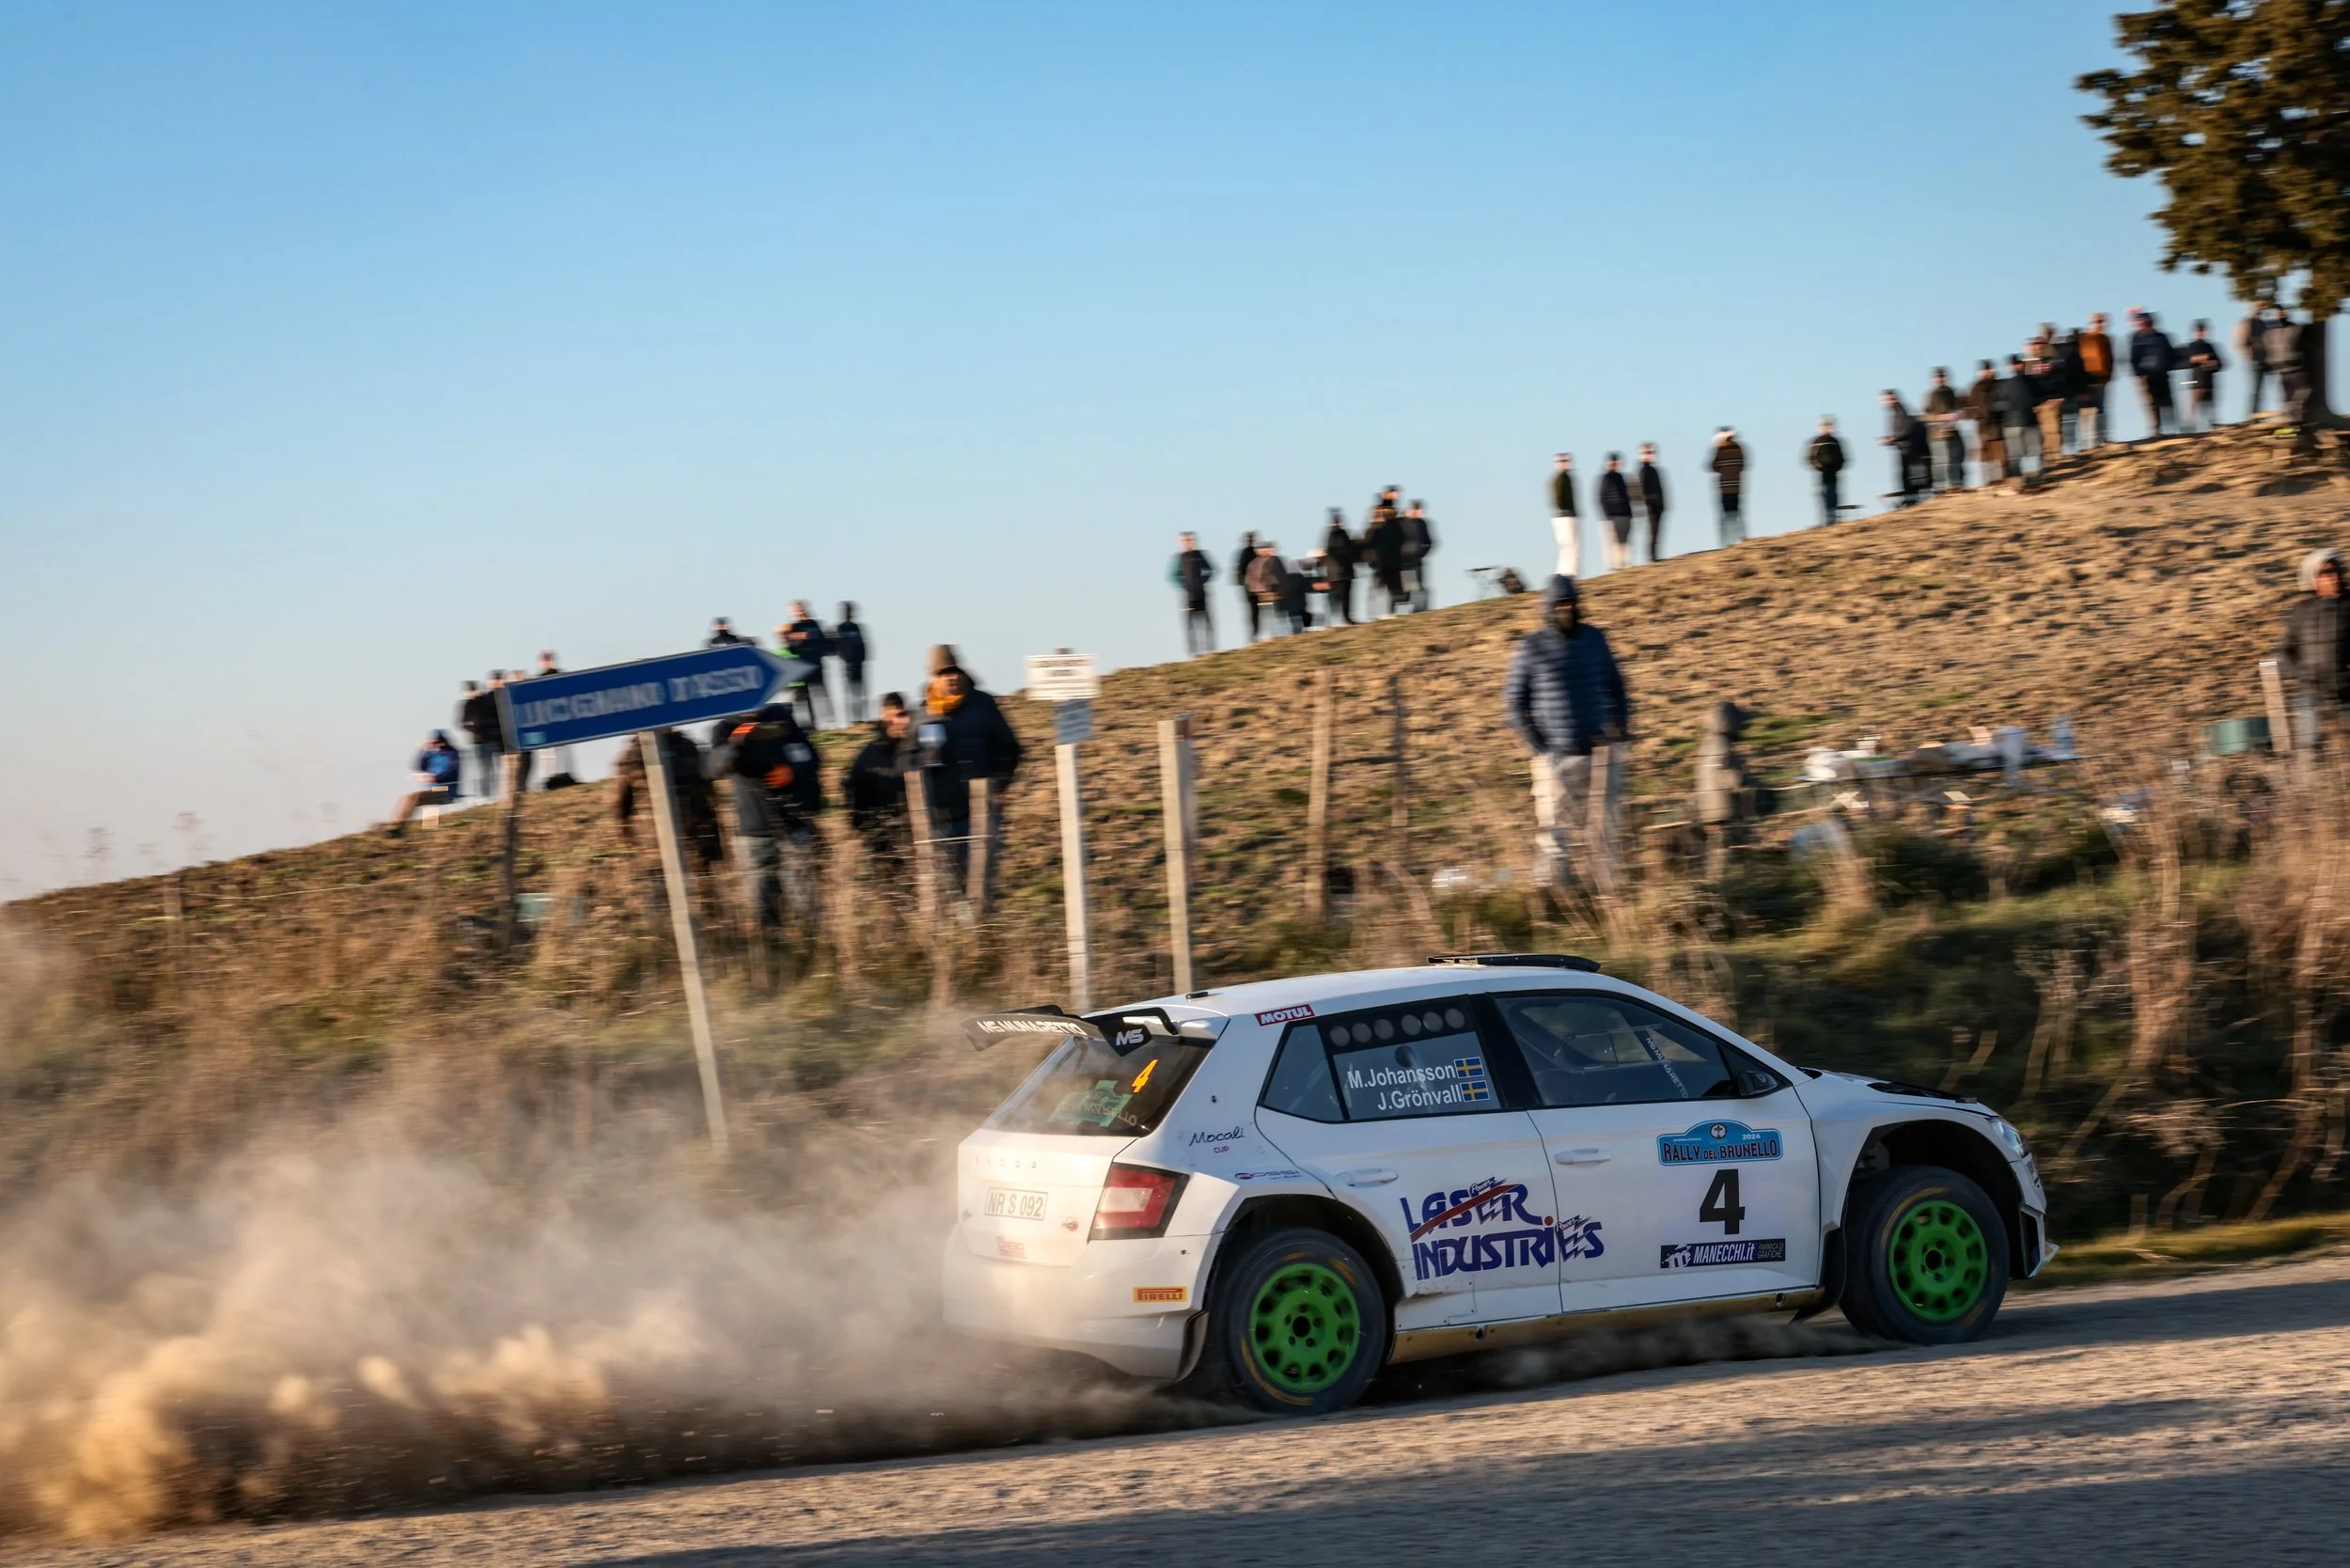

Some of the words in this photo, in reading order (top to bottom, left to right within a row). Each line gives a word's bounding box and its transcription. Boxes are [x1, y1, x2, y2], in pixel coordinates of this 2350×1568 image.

[1260, 1006, 1312, 1026] MOTUL
[1116, 1028, 1145, 1046] MS
[1131, 1058, 1158, 1093] 4
[1347, 1064, 1457, 1089] M.Johansson
[1377, 1085, 1463, 1111] J.Grönvall
[1189, 1126, 1246, 1147] Mocali
[1663, 1142, 1700, 1162] RALLY
[1703, 1150, 1717, 1160] DEL
[1719, 1139, 1778, 1159] BRUNELLO
[987, 1191, 1006, 1214] NR
[1008, 1193, 1017, 1215] S
[1019, 1195, 1044, 1217] 092
[1700, 1168, 1746, 1235] 4
[1693, 1243, 1755, 1264] MANECCHI.it
[1137, 1288, 1183, 1301] PIRELLI
